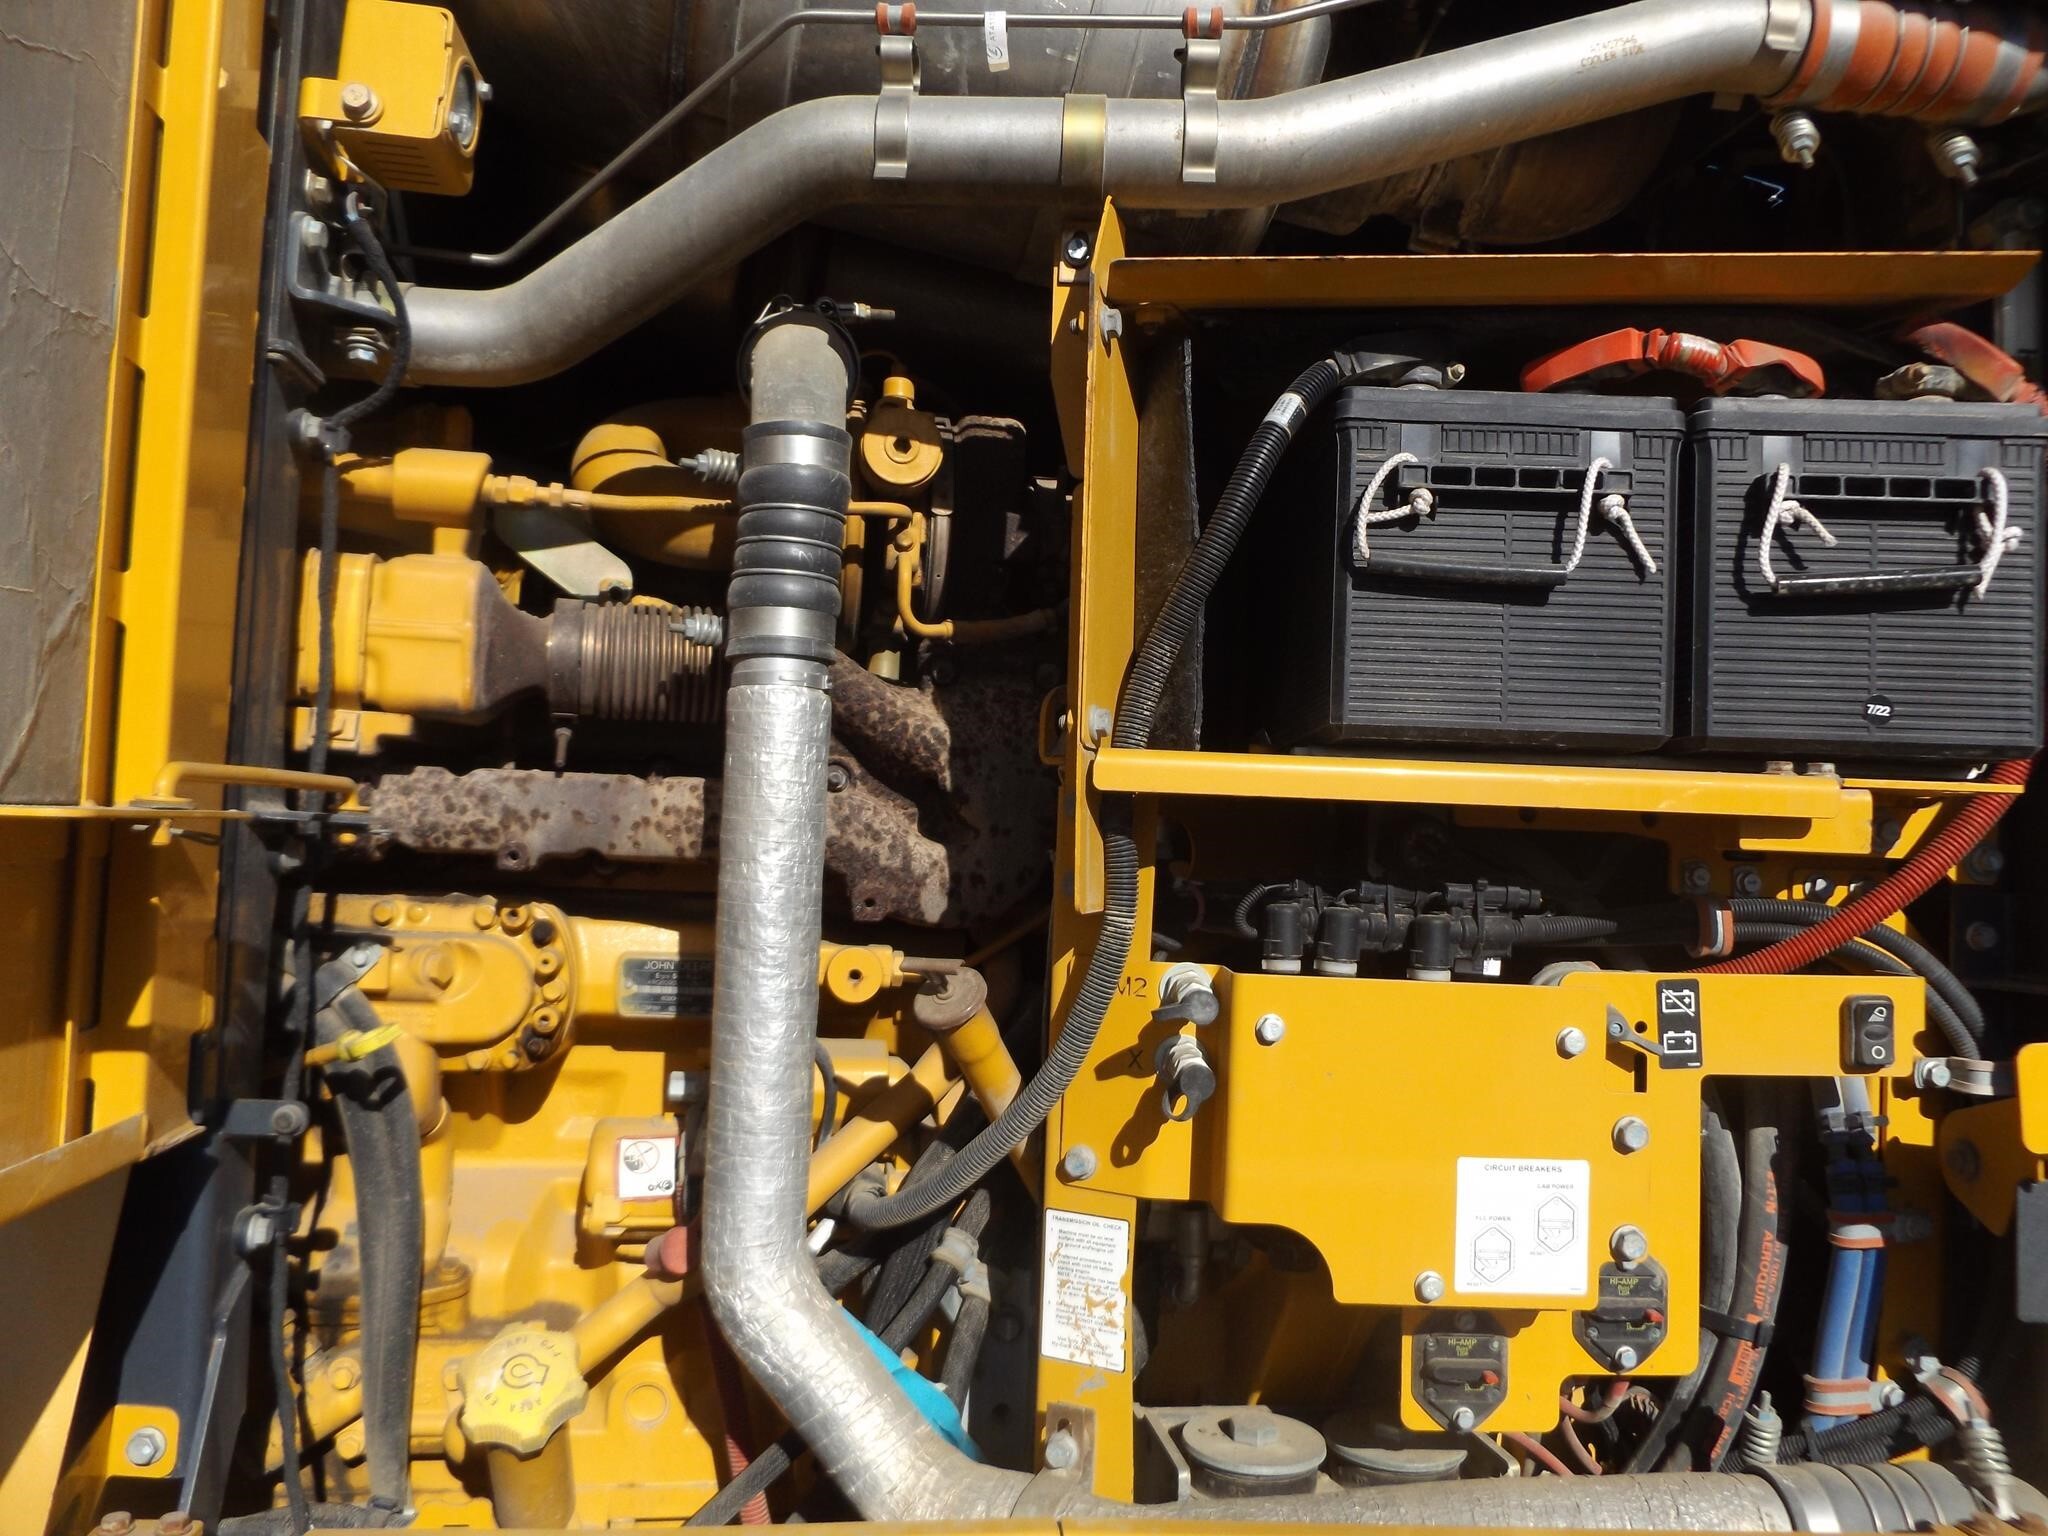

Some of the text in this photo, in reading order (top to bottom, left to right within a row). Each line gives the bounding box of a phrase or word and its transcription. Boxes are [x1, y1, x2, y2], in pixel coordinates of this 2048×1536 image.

[1866, 704, 1891, 717] 7/22
[644, 960, 675, 970] JOHN
[1484, 1164, 1562, 1173] CIRCUIT BREAKERS
[1052, 1215, 1091, 1226] TRANSMISSION
[1753, 1230, 1774, 1310] AEROQUIP
[1609, 1277, 1640, 1285] HI-AMP
[1448, 1337, 1478, 1345] HI-AMP
